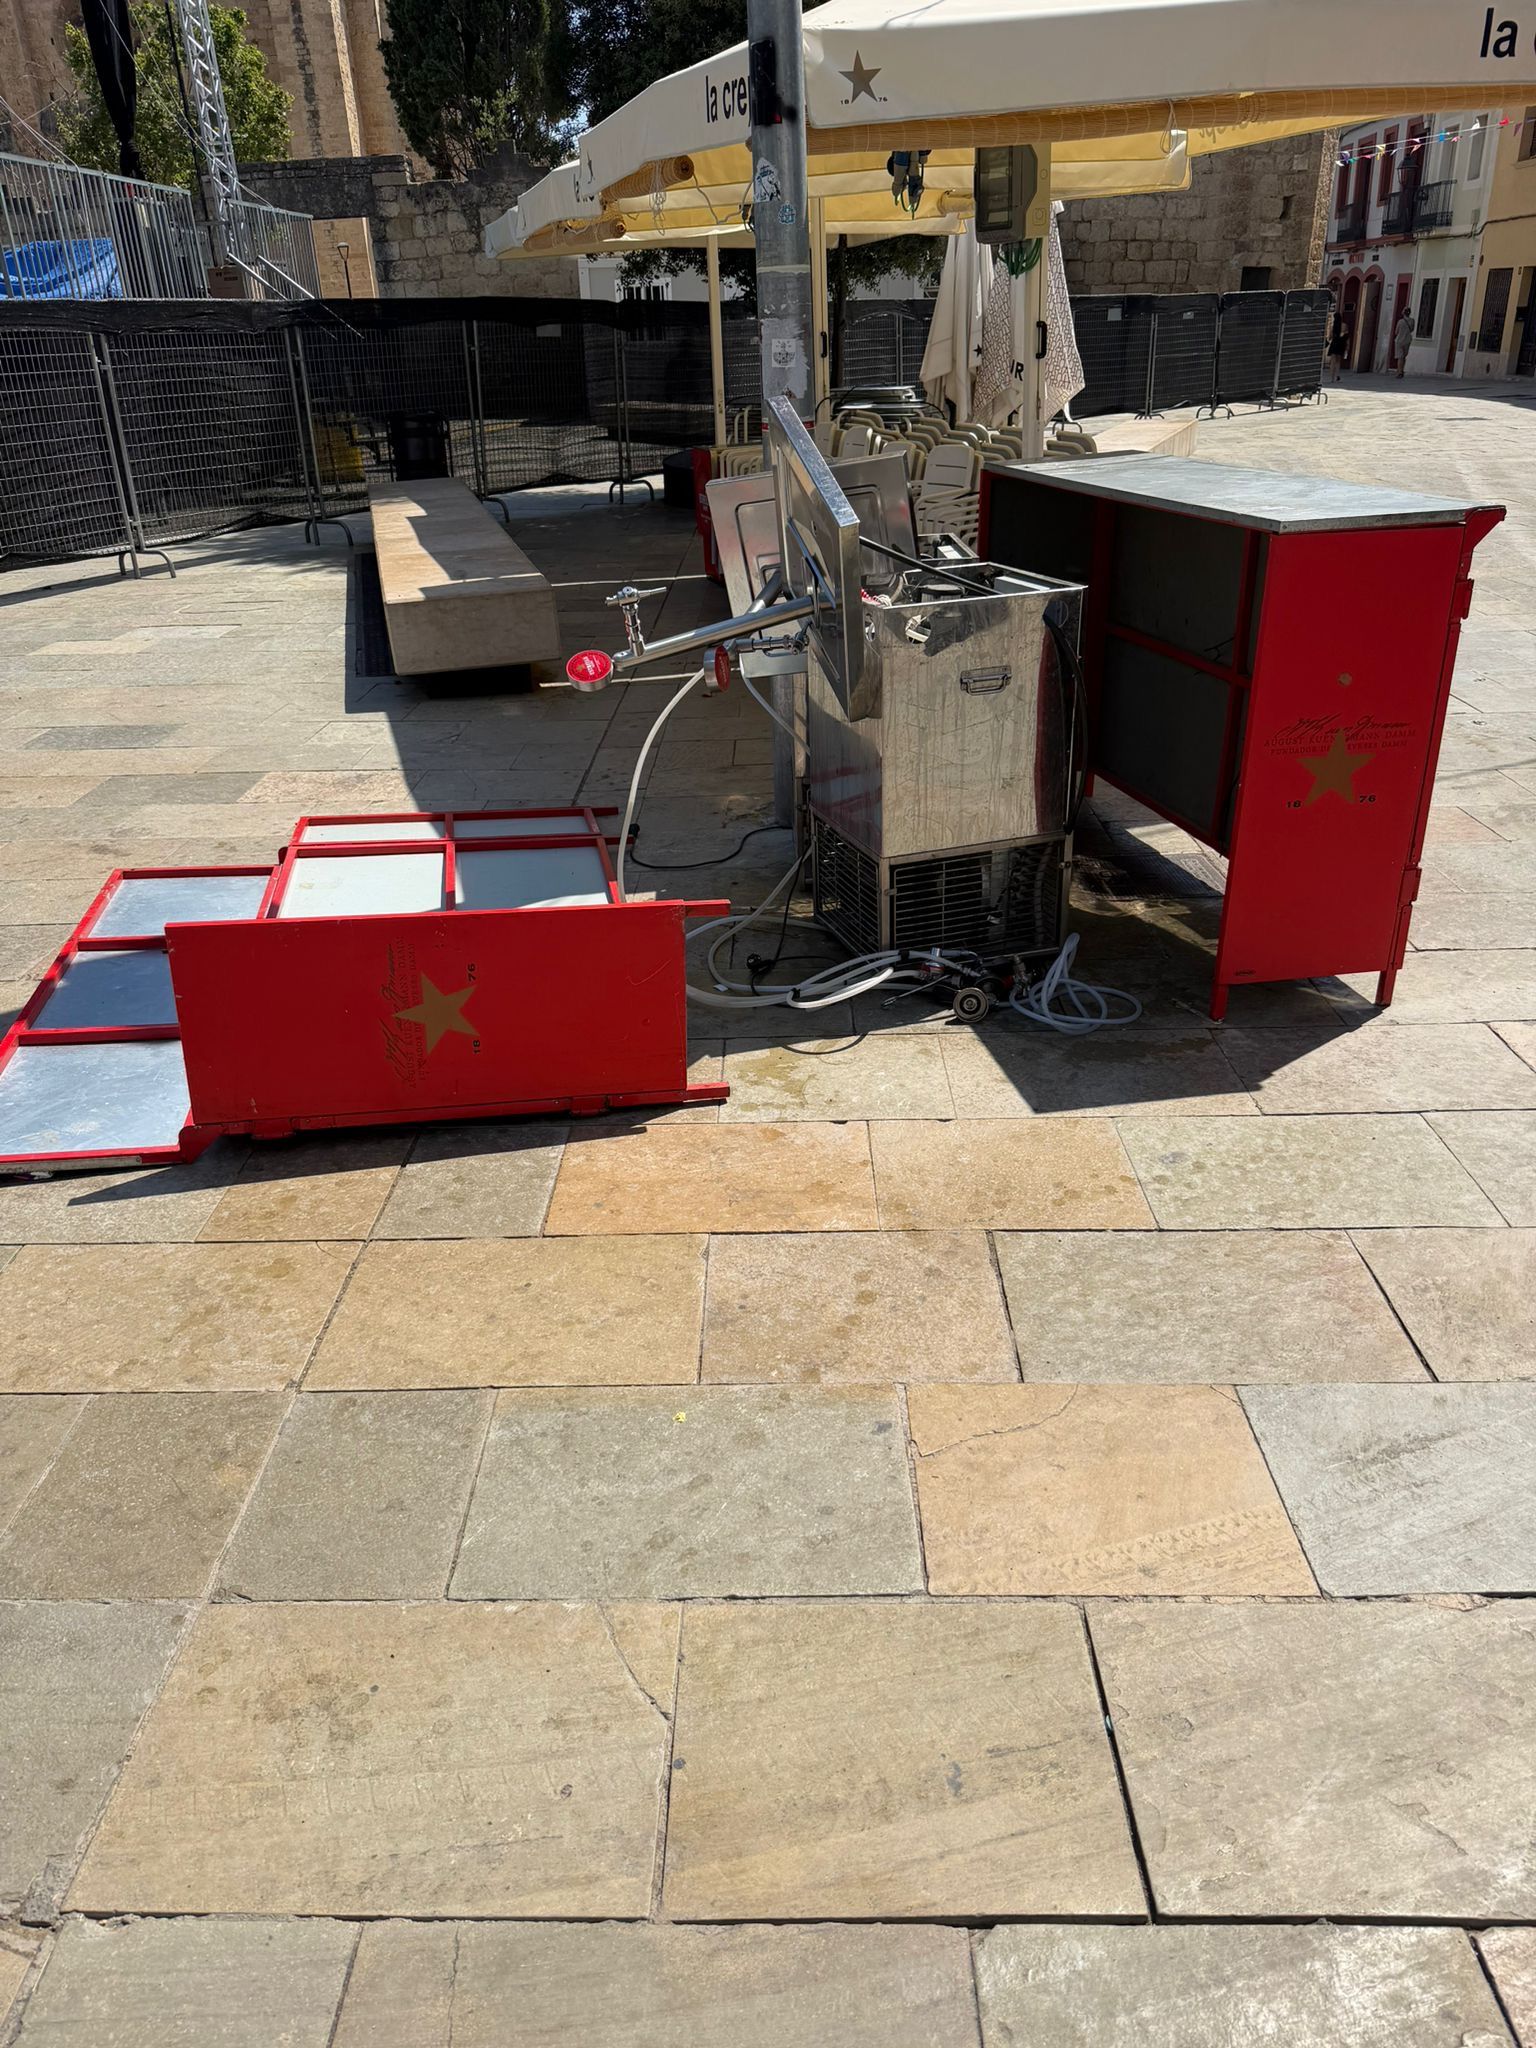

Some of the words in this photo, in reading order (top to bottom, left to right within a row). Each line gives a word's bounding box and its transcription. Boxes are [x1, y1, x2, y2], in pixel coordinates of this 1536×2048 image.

[1480, 7, 1518, 58] la
[705, 75, 718, 123] la
[722, 75, 751, 128] cre
[1286, 799, 1302, 809] 18
[1359, 794, 1377, 804] 76
[467, 963, 477, 982] 76
[472, 1039, 481, 1055] 18
